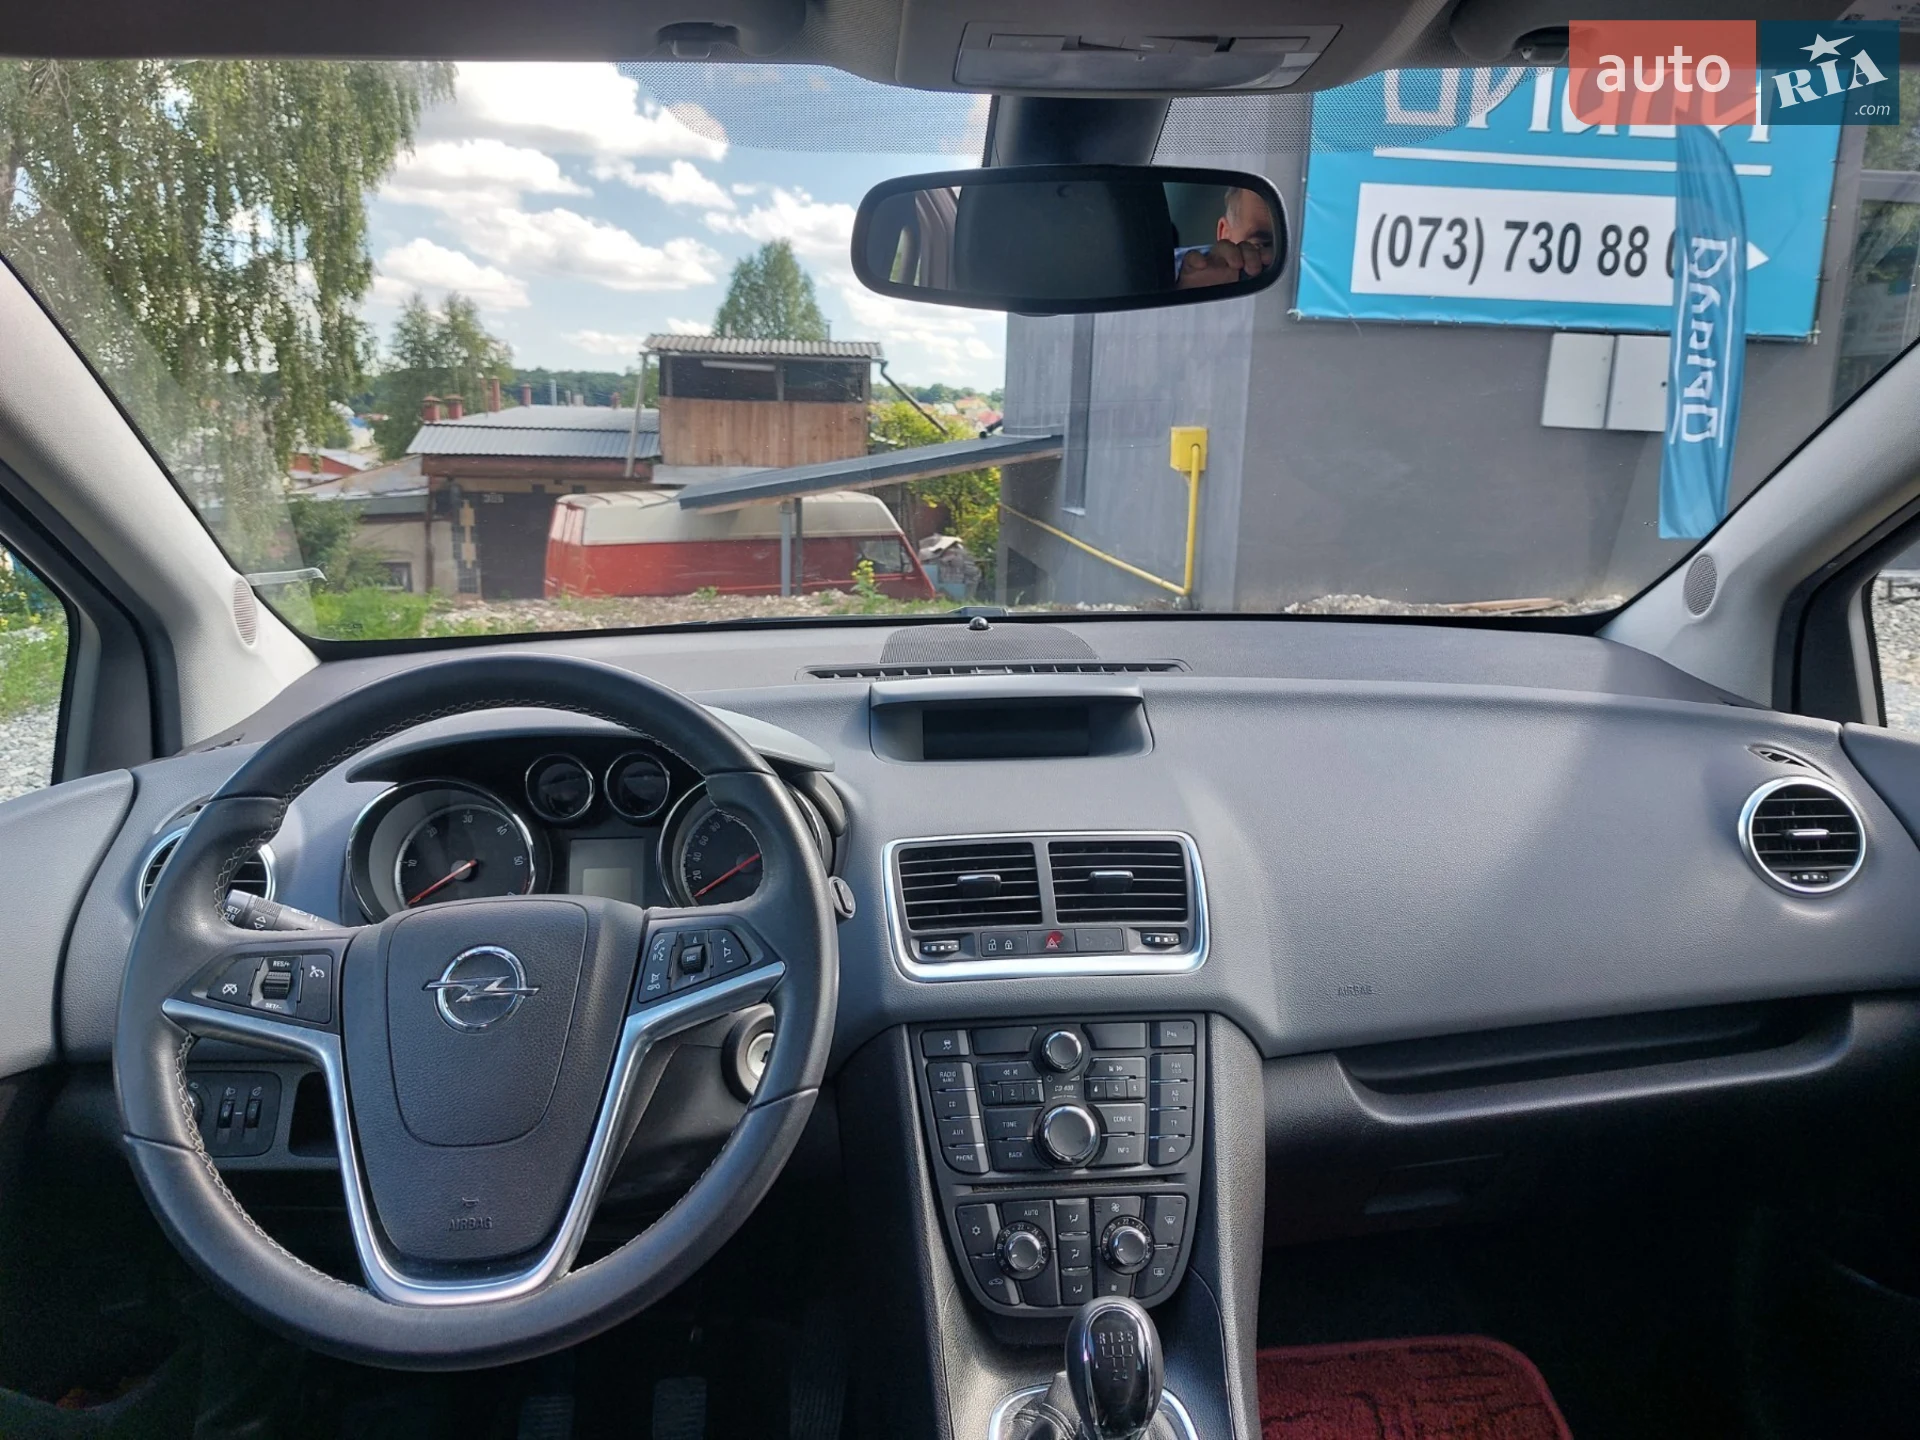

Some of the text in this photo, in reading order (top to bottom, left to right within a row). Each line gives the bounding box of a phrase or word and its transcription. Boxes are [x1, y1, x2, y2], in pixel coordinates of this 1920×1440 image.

[1371, 213, 1485, 286] (073)
[1503, 219, 1582, 275] 730
[1596, 223, 1650, 278] 88
[462, 814, 473, 824] 30
